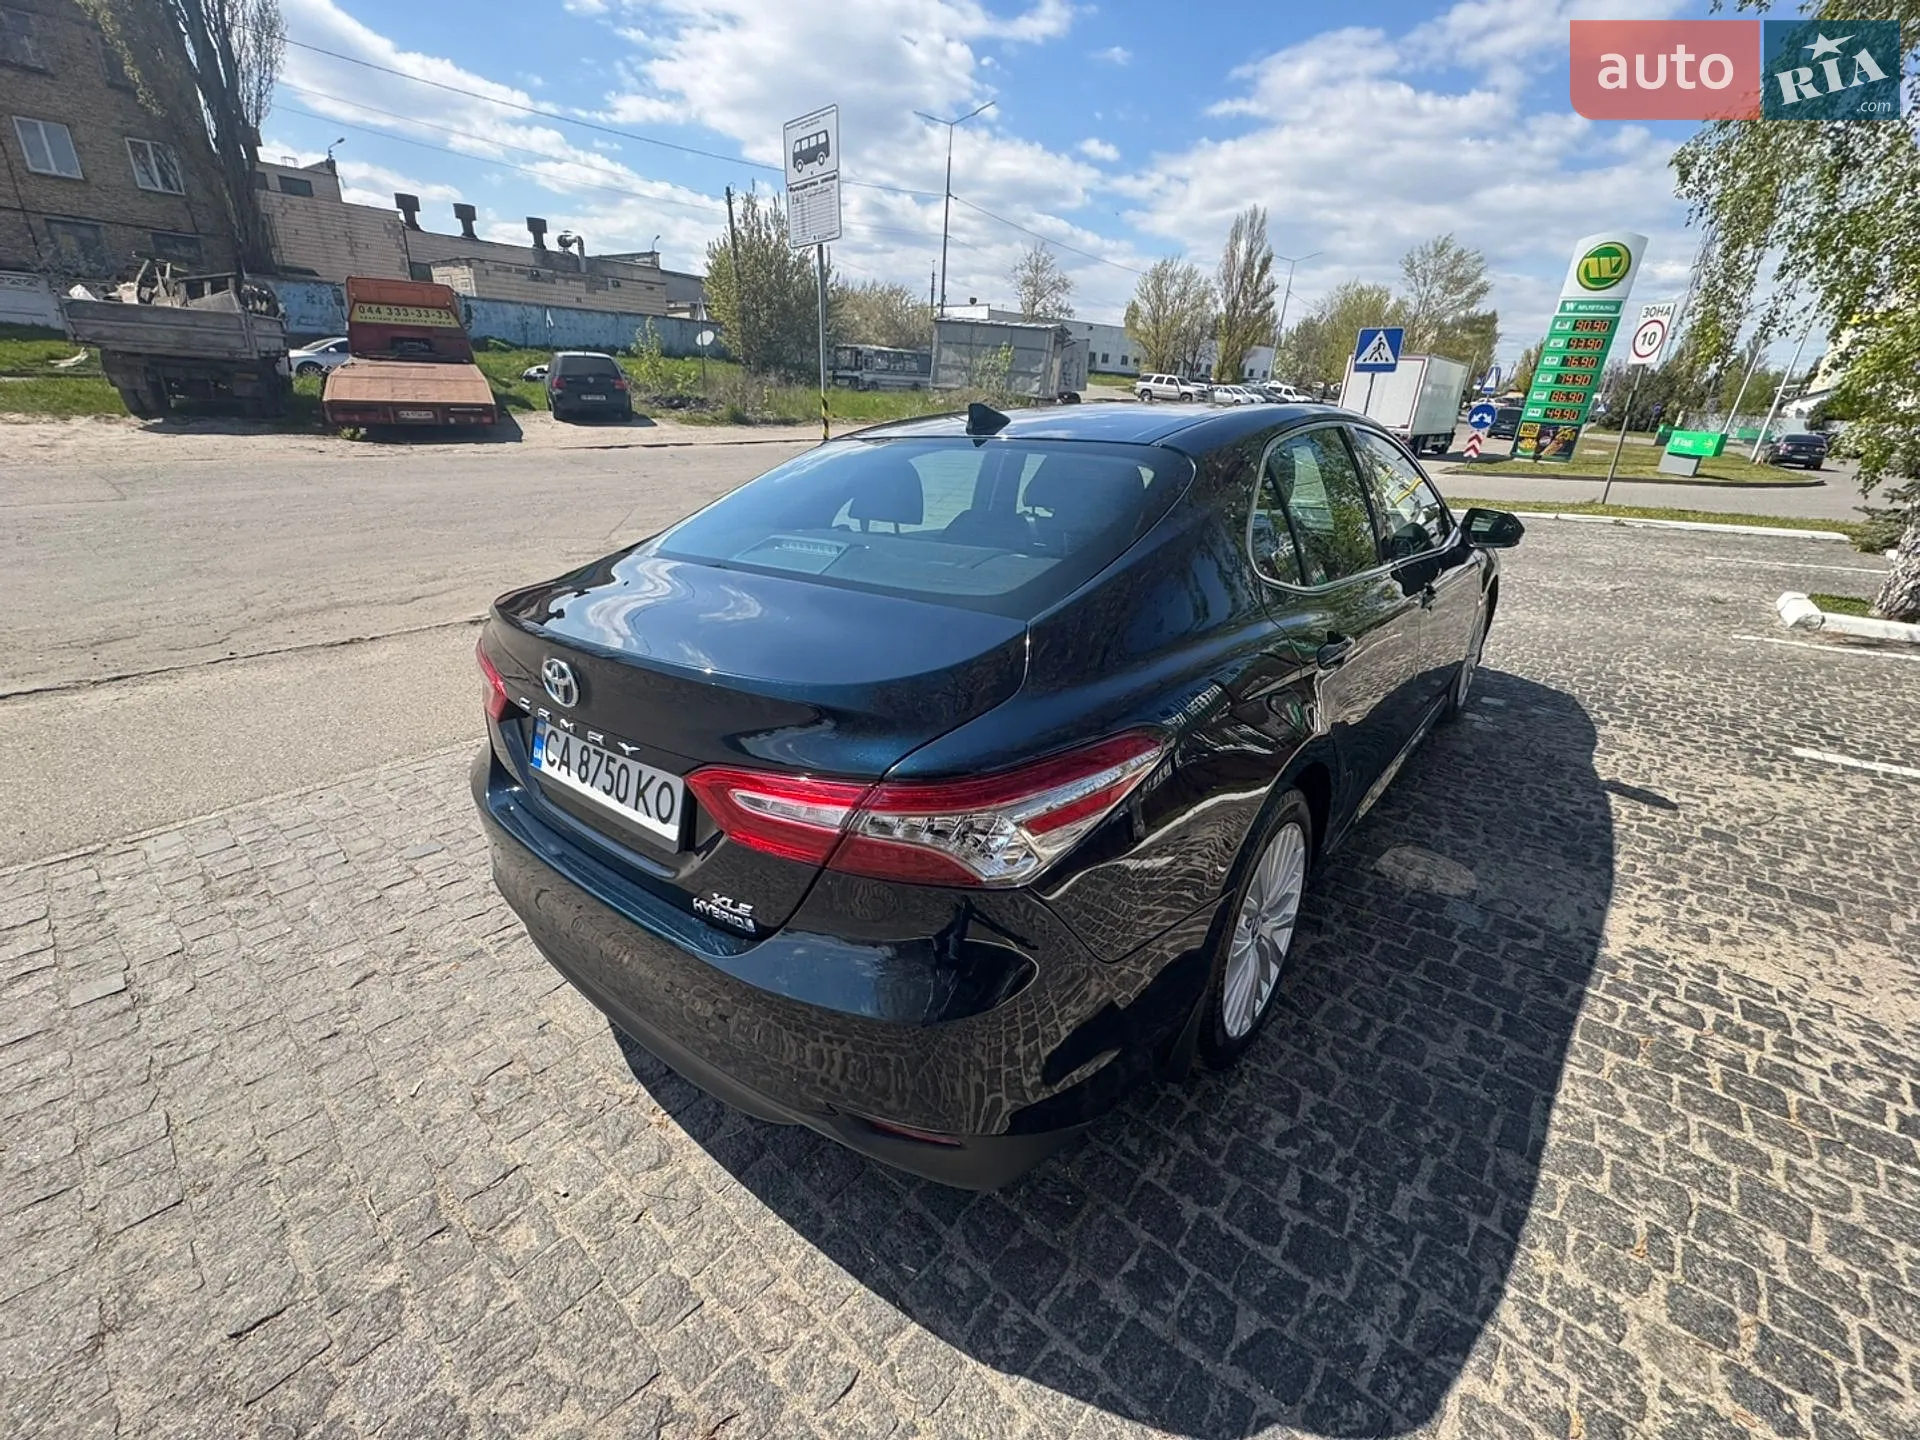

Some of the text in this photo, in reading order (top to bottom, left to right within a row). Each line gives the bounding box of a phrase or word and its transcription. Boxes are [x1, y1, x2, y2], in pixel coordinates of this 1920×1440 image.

[358, 304, 383, 315] 044
[386, 306, 451, 320] 333-33-33
[1577, 303, 1616, 312] MUSTANG
[1643, 306, 1671, 319] ЗОНА
[1575, 319, 1610, 332] 90.90
[1641, 331, 1657, 346] 10
[1546, 408, 1579, 421] 49.90
[519, 696, 640, 757] CAMRY
[545, 730, 675, 825] CA 8750 KO
[711, 892, 754, 917] XLE
[692, 897, 746, 929] HYBRID
